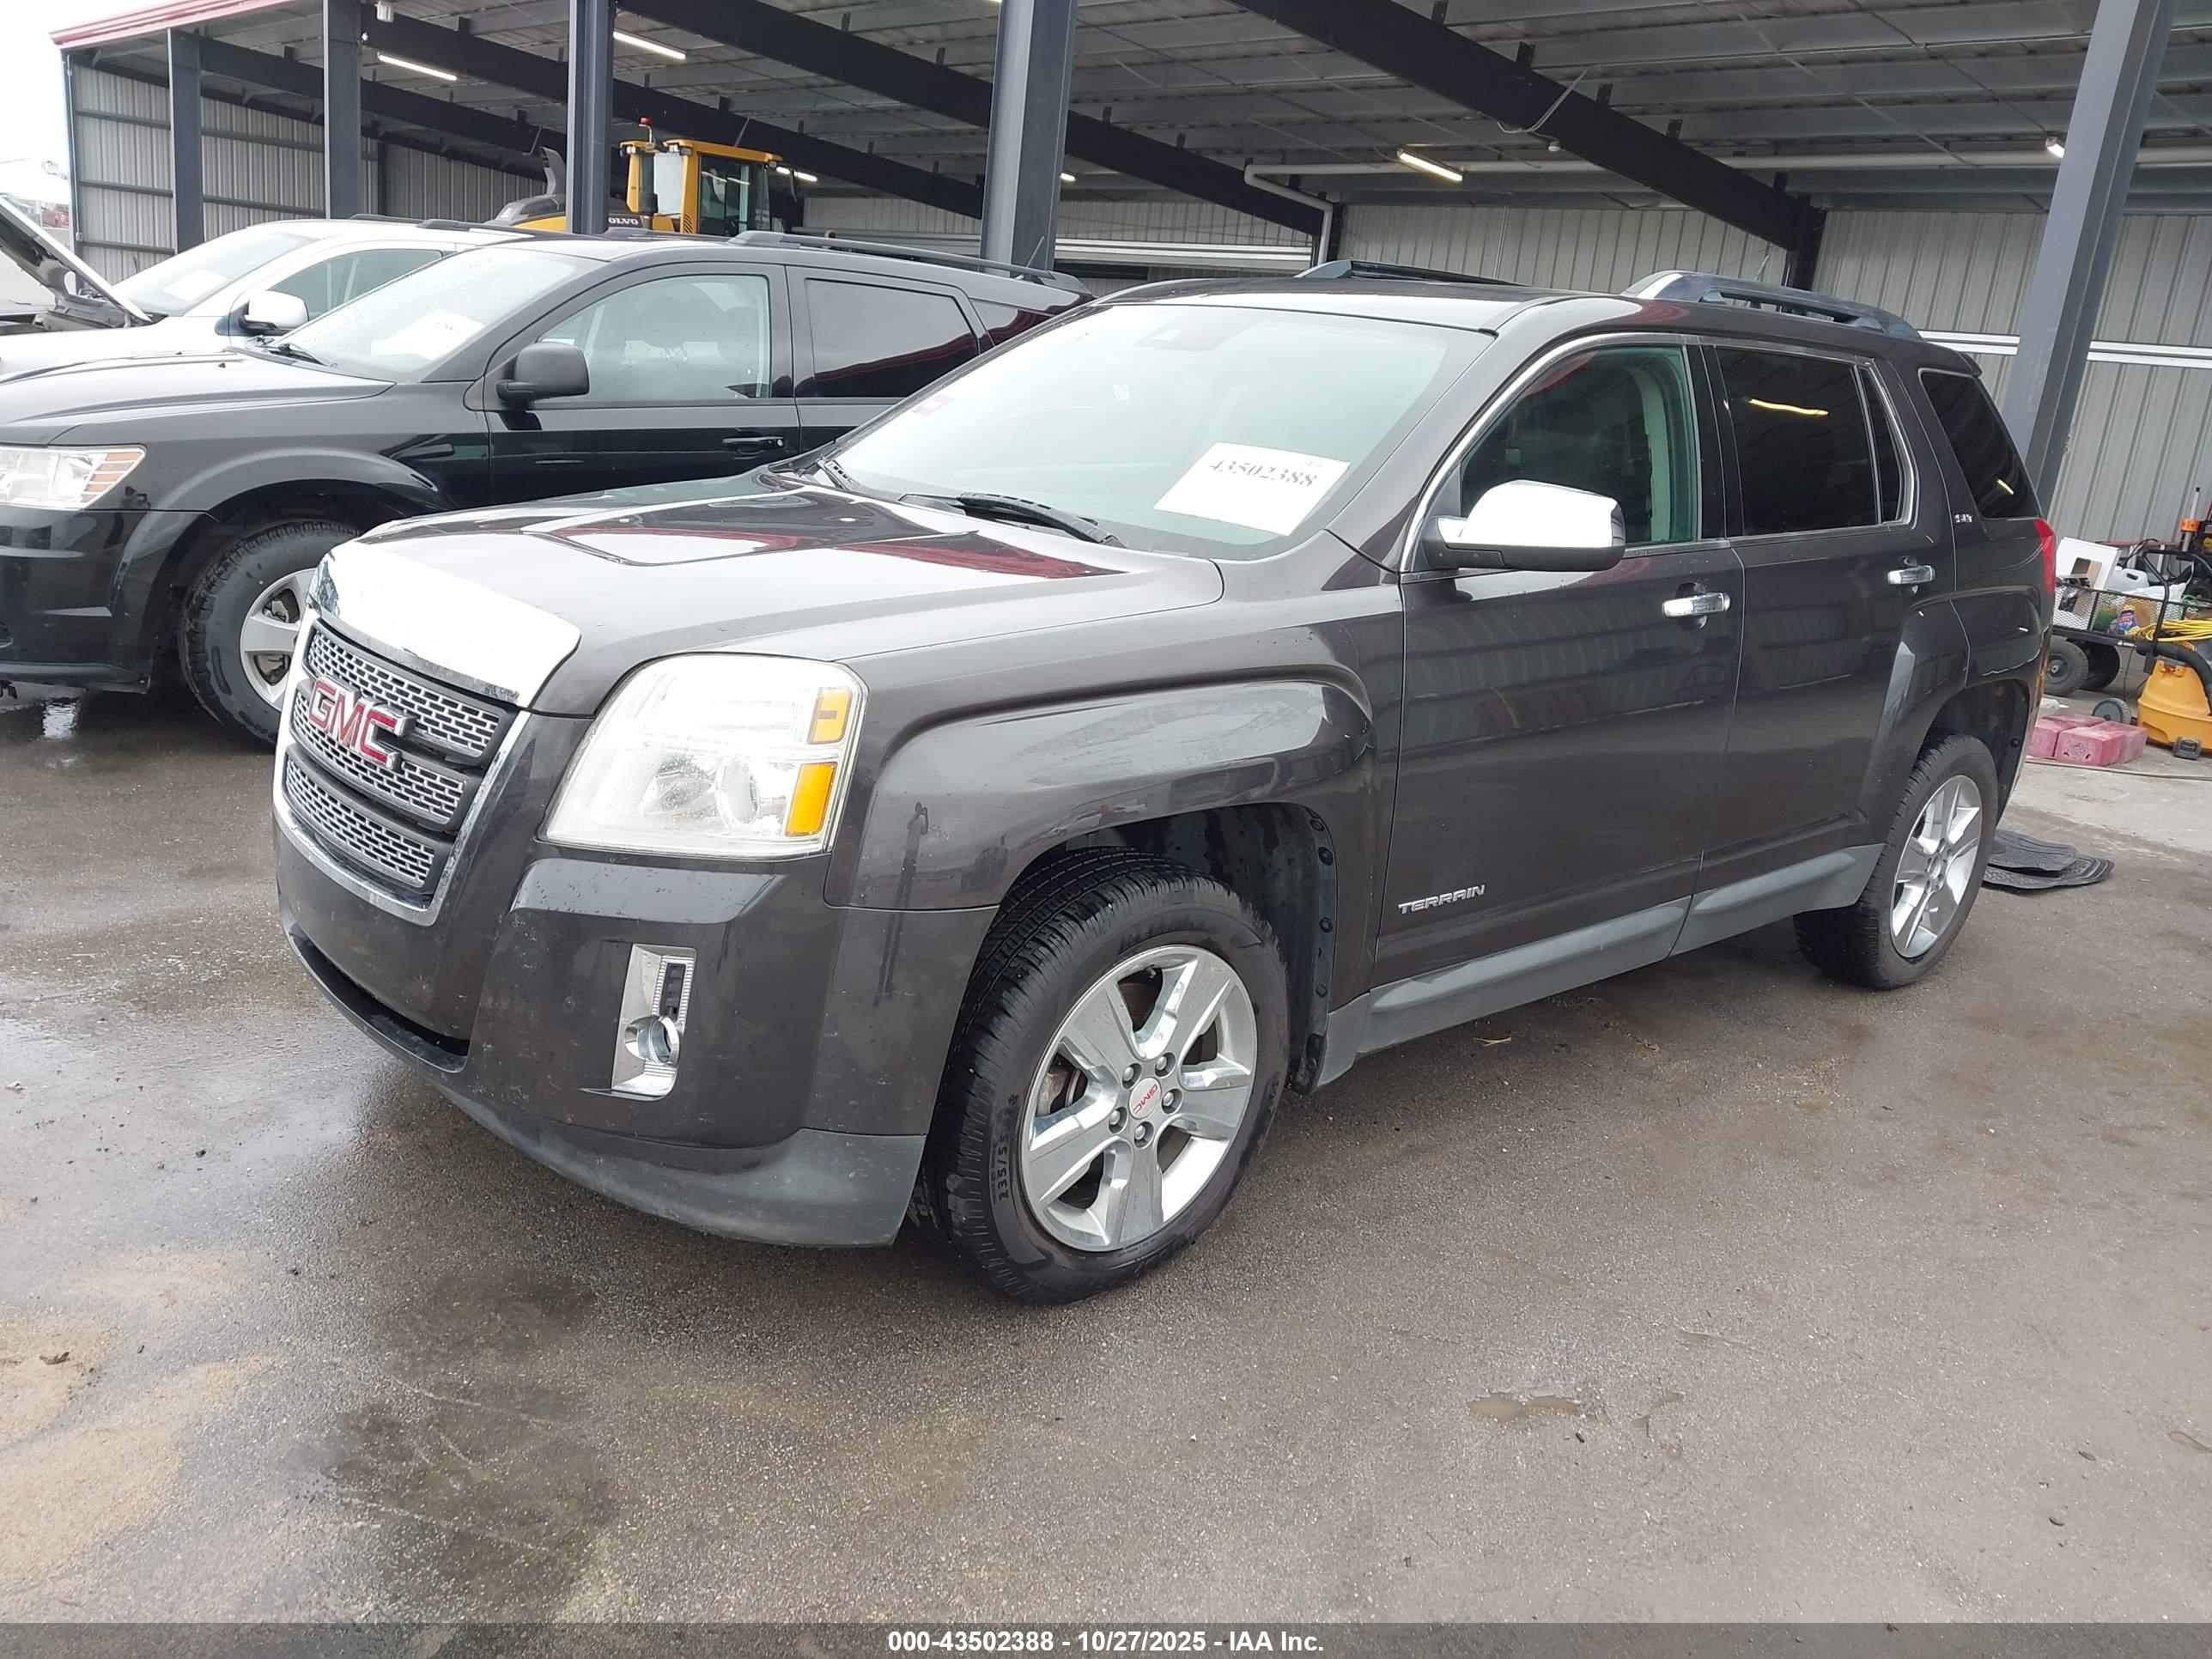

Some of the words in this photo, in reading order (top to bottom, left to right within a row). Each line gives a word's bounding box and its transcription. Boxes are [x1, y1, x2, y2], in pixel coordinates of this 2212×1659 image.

[1208, 459, 1318, 487] 43502388
[309, 675, 406, 770] GMC
[1398, 884, 1486, 915] TERRAIN
[1133, 1084, 1158, 1115] GMC
